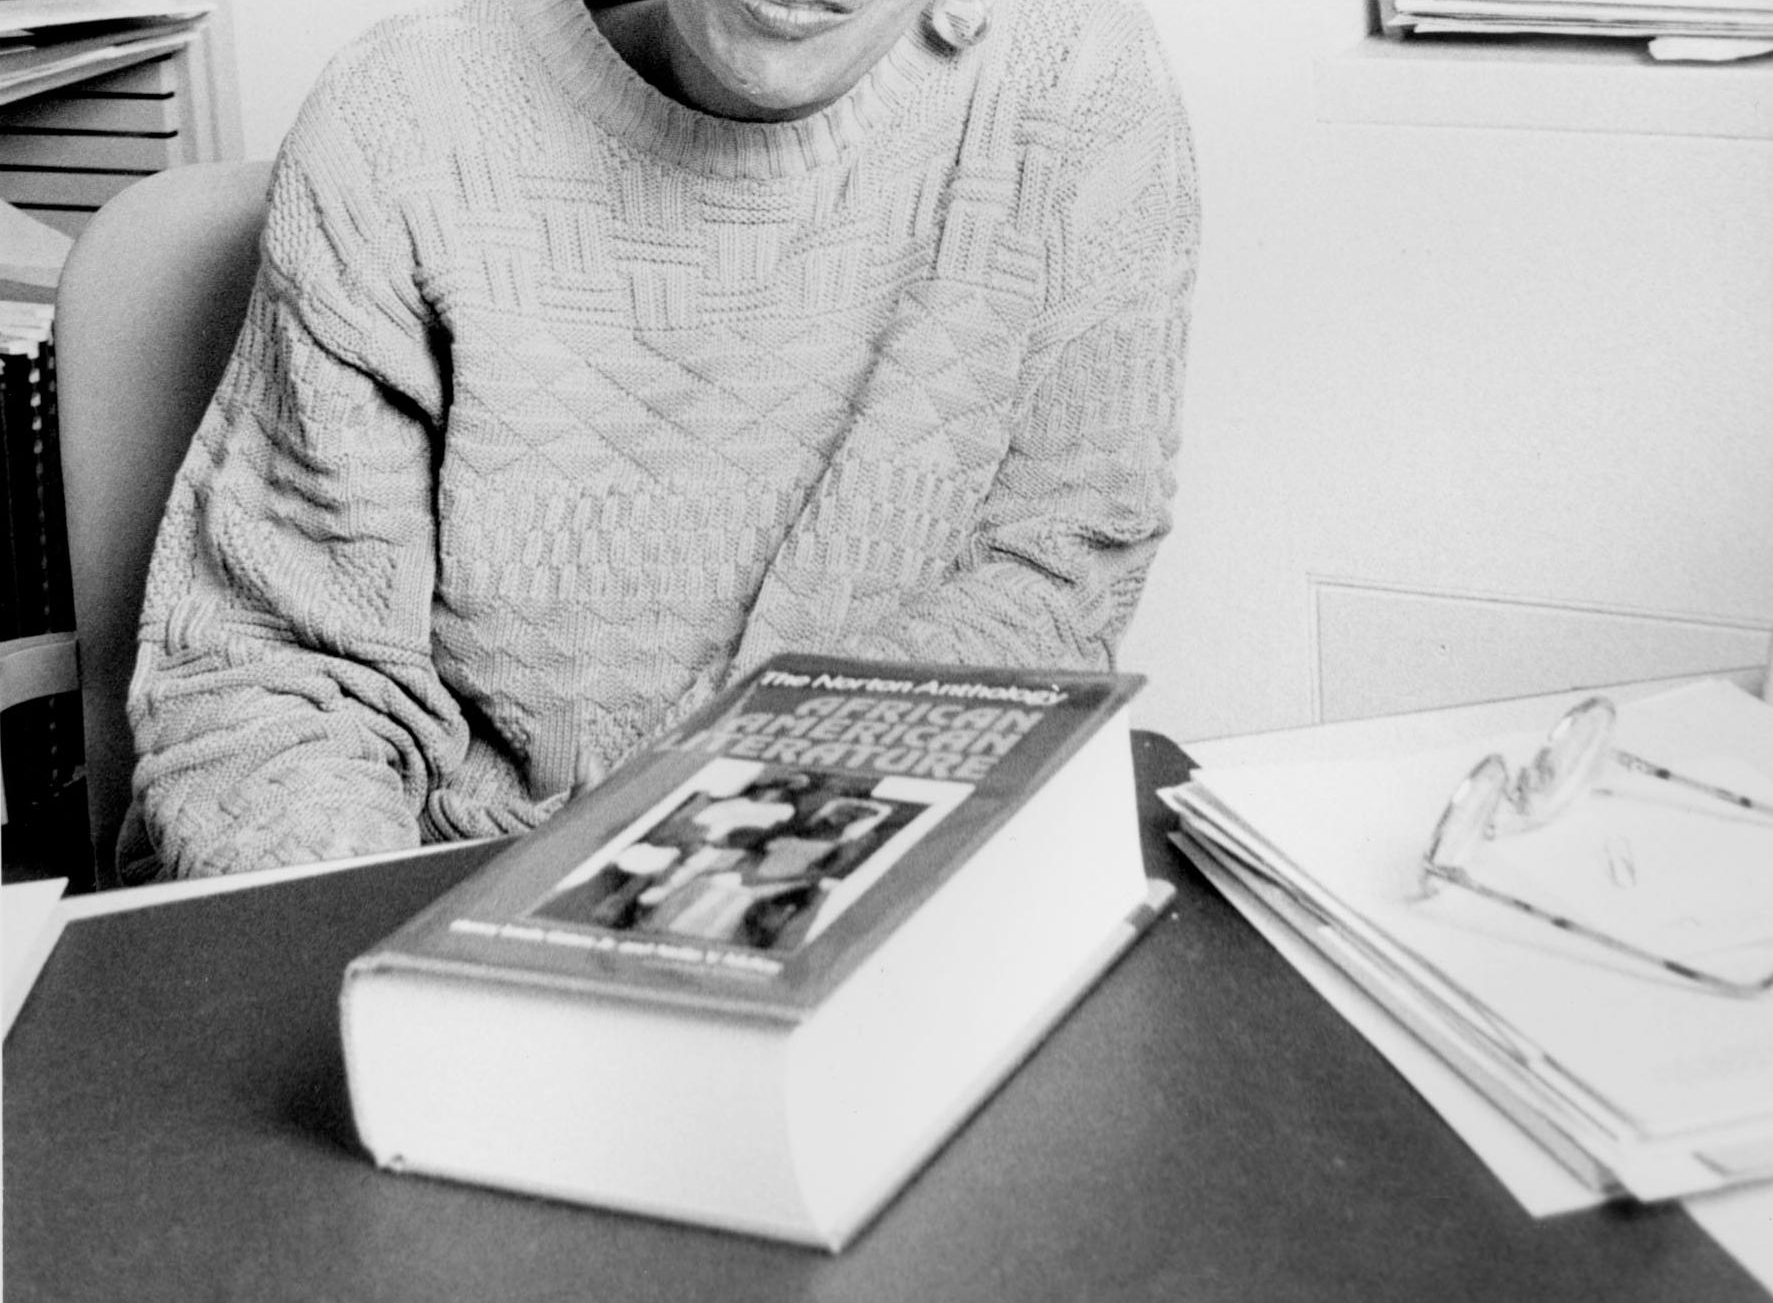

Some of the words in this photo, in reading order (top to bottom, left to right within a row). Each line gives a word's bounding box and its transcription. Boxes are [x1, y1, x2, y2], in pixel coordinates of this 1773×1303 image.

[761, 671, 811, 688] The
[812, 674, 913, 693] Norton
[913, 679, 1068, 706] Anthology
[795, 696, 1044, 734] AFRICAN
[720, 712, 1023, 757] AMERICAN
